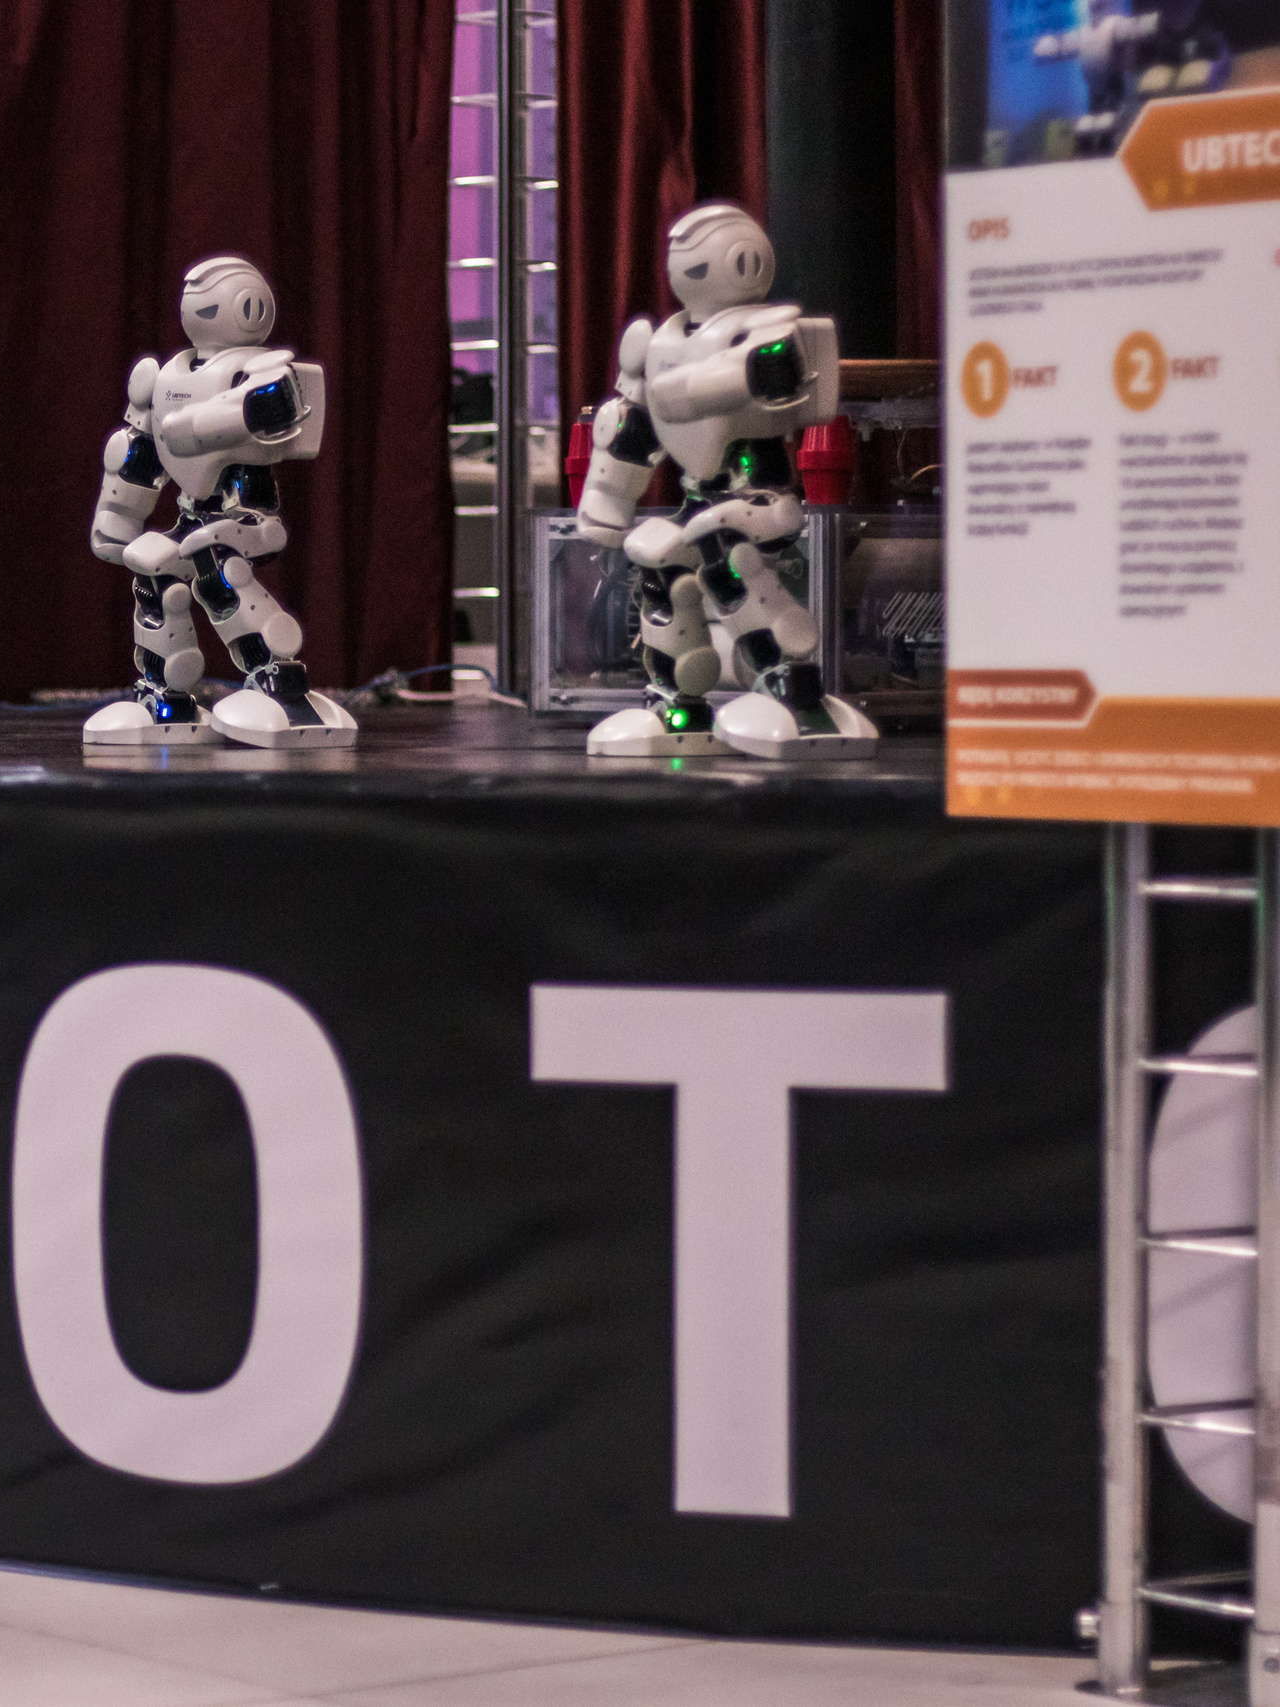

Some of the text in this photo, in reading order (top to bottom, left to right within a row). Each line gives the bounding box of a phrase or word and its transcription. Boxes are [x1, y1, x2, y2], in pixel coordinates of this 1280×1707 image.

[1182, 129, 1280, 173] UBTEC
[968, 217, 1010, 241] OPIS
[977, 358, 1058, 401] 1 FAKT
[1129, 348, 1220, 394] 2 FAKT
